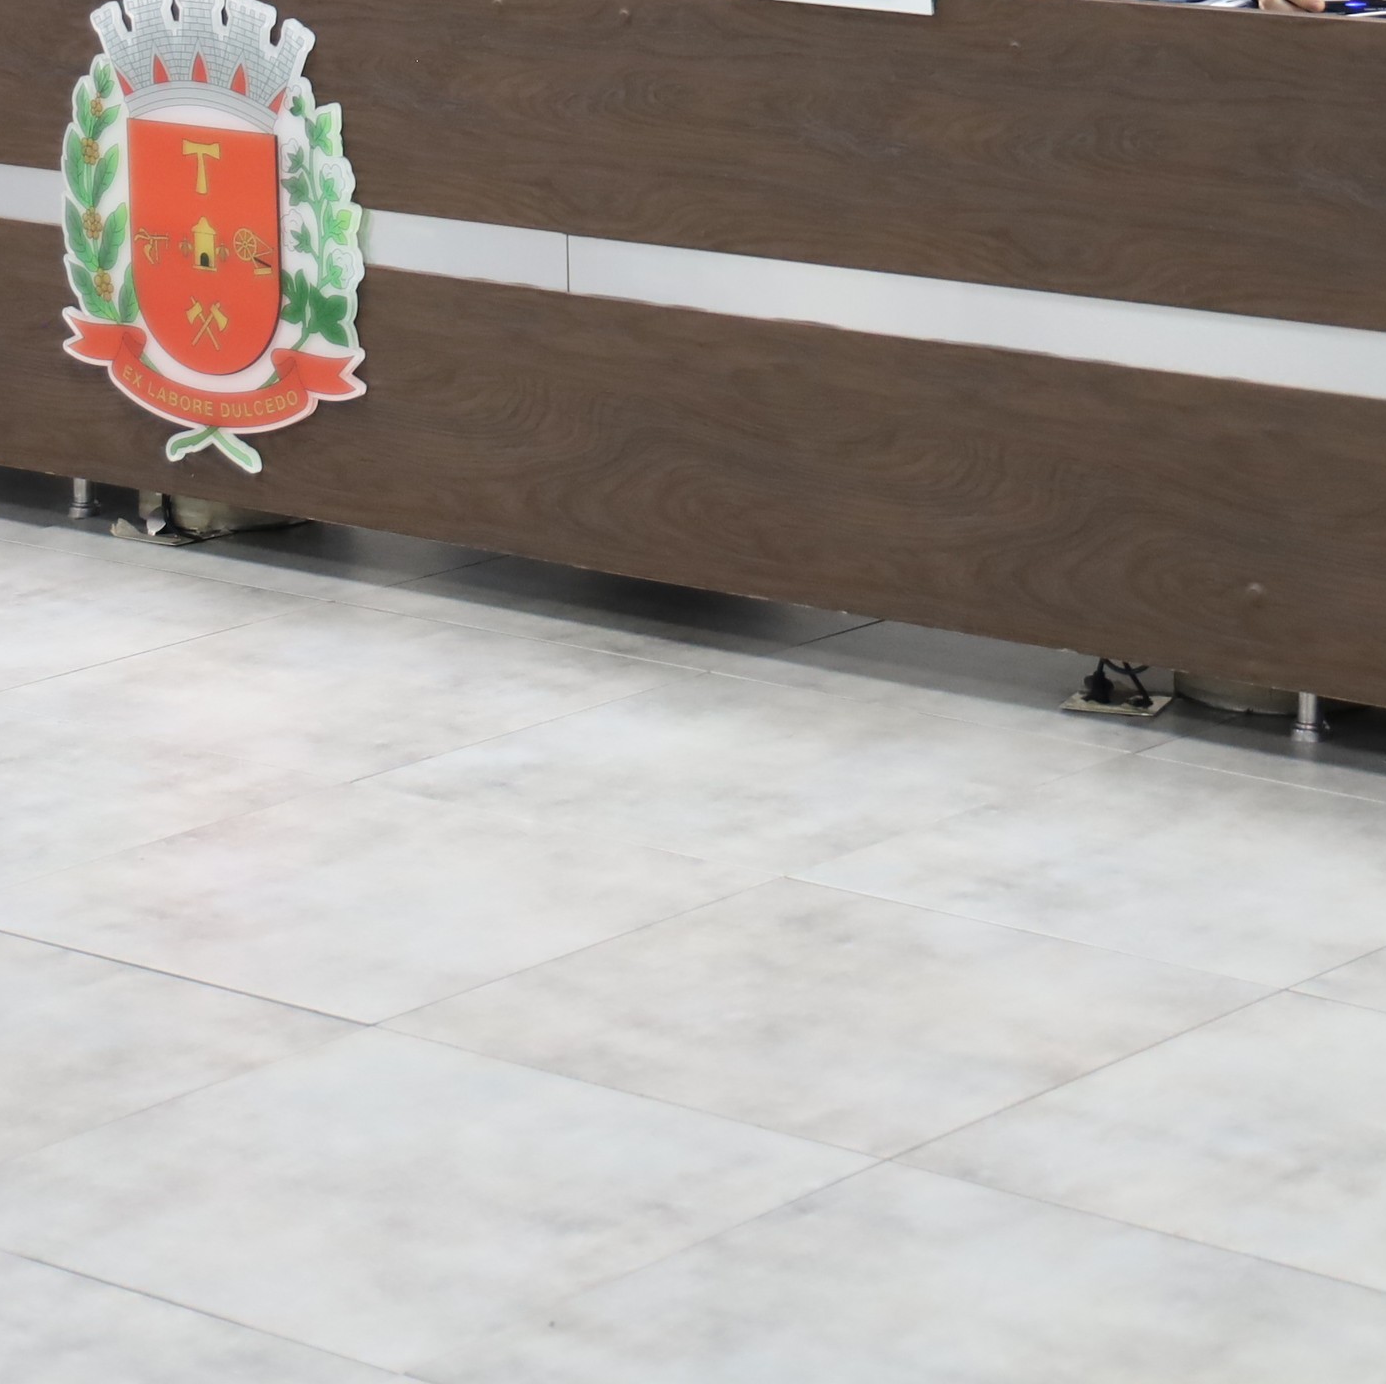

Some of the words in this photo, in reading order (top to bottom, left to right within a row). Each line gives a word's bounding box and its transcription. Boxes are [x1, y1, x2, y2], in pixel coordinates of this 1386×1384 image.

[123, 365, 141, 388] EX
[148, 381, 213, 416] LABORE
[220, 390, 299, 418] DULCEDO
